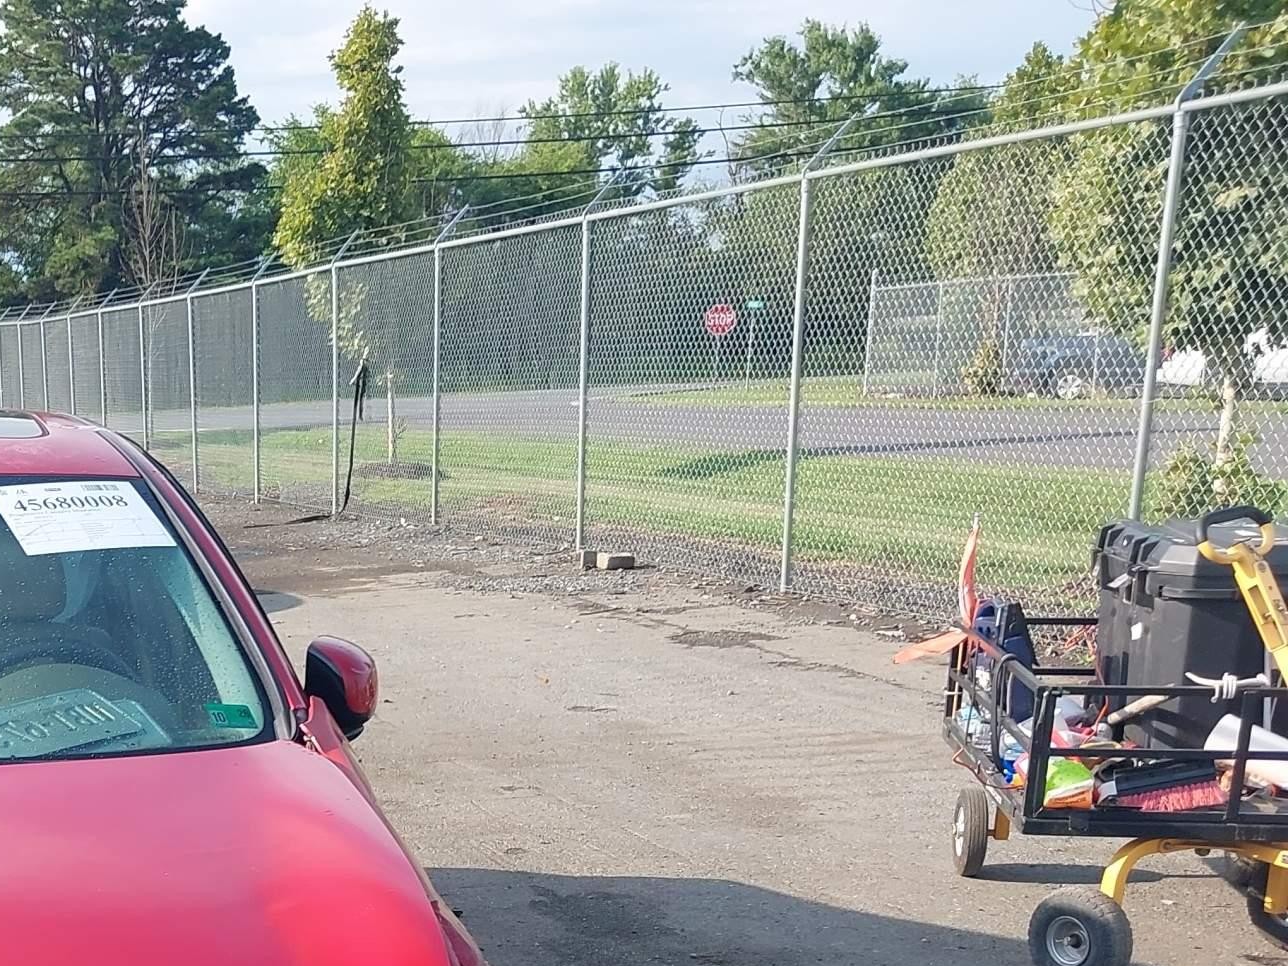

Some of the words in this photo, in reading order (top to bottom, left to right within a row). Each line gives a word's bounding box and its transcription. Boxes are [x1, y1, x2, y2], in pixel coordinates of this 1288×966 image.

[708, 311, 734, 325] STOP
[14, 495, 128, 511] 45680008
[211, 711, 226, 723] 10
